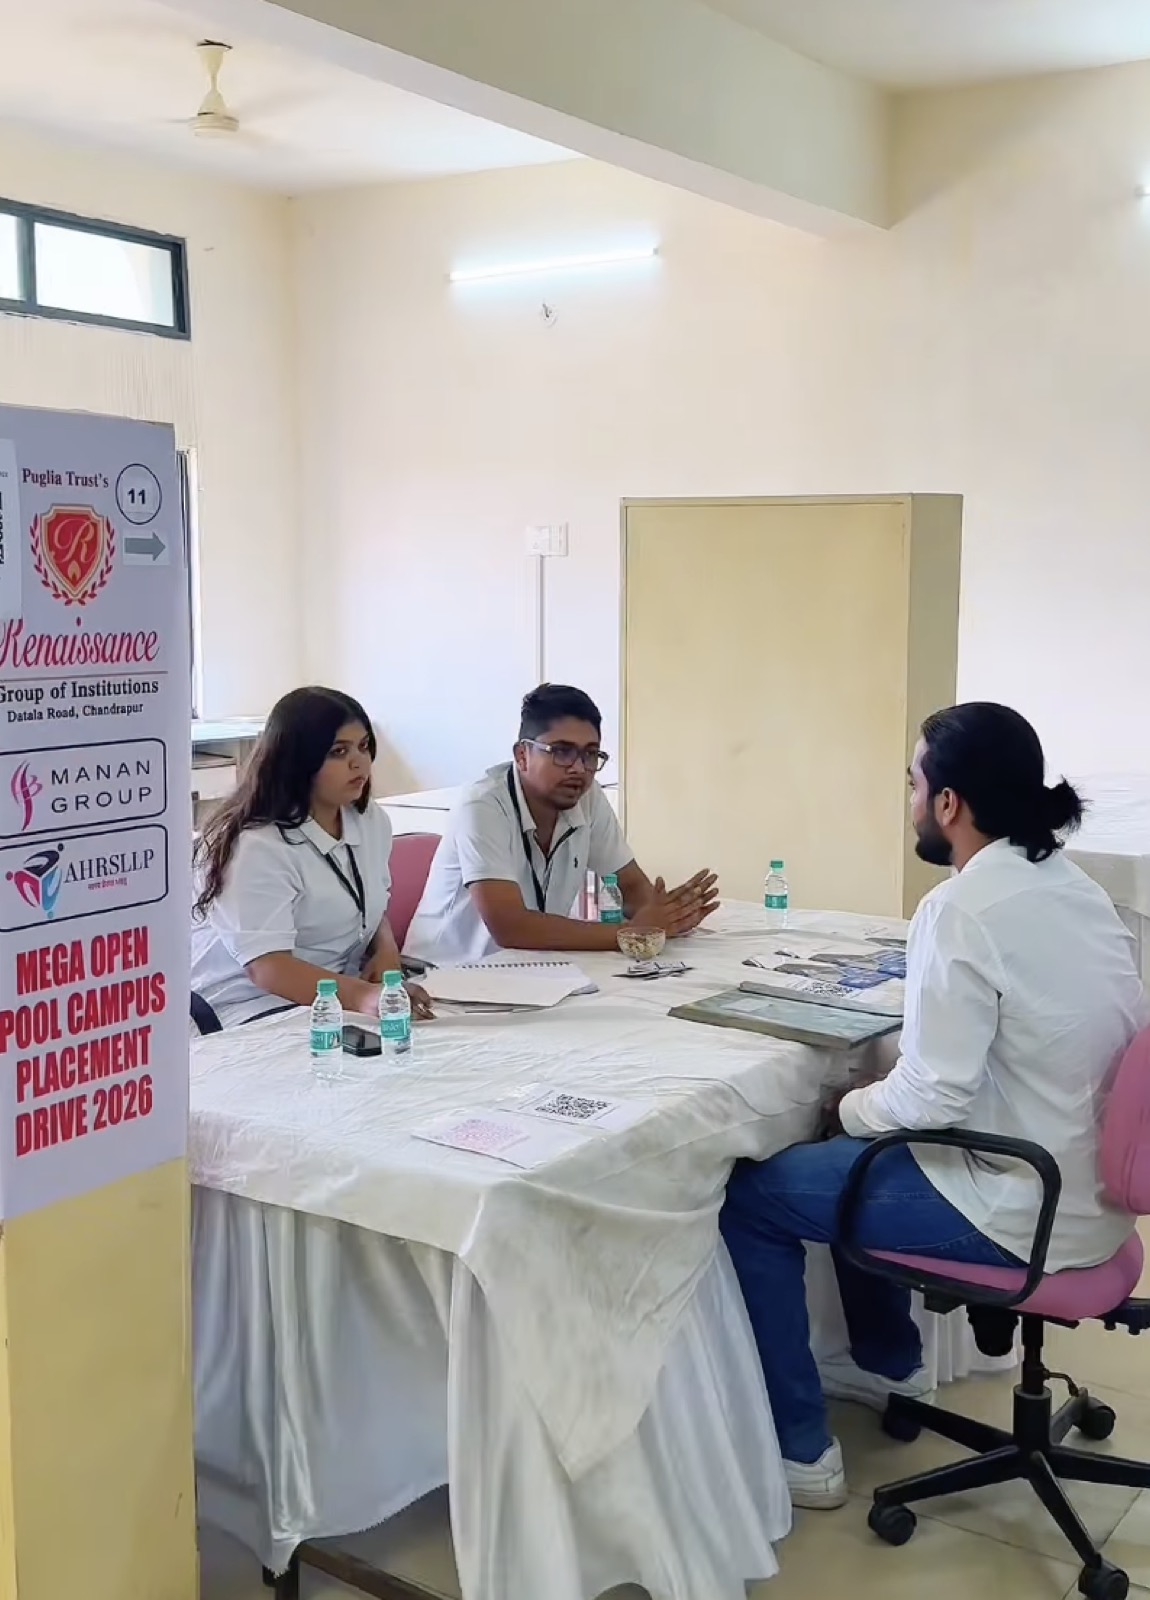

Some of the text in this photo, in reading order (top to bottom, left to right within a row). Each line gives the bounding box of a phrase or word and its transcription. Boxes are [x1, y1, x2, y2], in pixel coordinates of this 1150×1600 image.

[22, 468, 109, 488] Puglia Trust's
[127, 488, 146, 505] 11
[50, 682, 67, 699] of
[72, 679, 159, 699] Institutions
[7, 702, 144, 723] Datala Road, Chandrapur
[51, 759, 151, 785] MANAN
[51, 786, 152, 813] GROUP
[64, 848, 154, 883] AHRSLLP
[16, 925, 149, 996] MEGA OPEN
[0, 971, 165, 1055] POOL CAMPUS
[16, 1024, 152, 1104] PLACEMENT
[16, 1074, 153, 1158] DRIVE 2026
